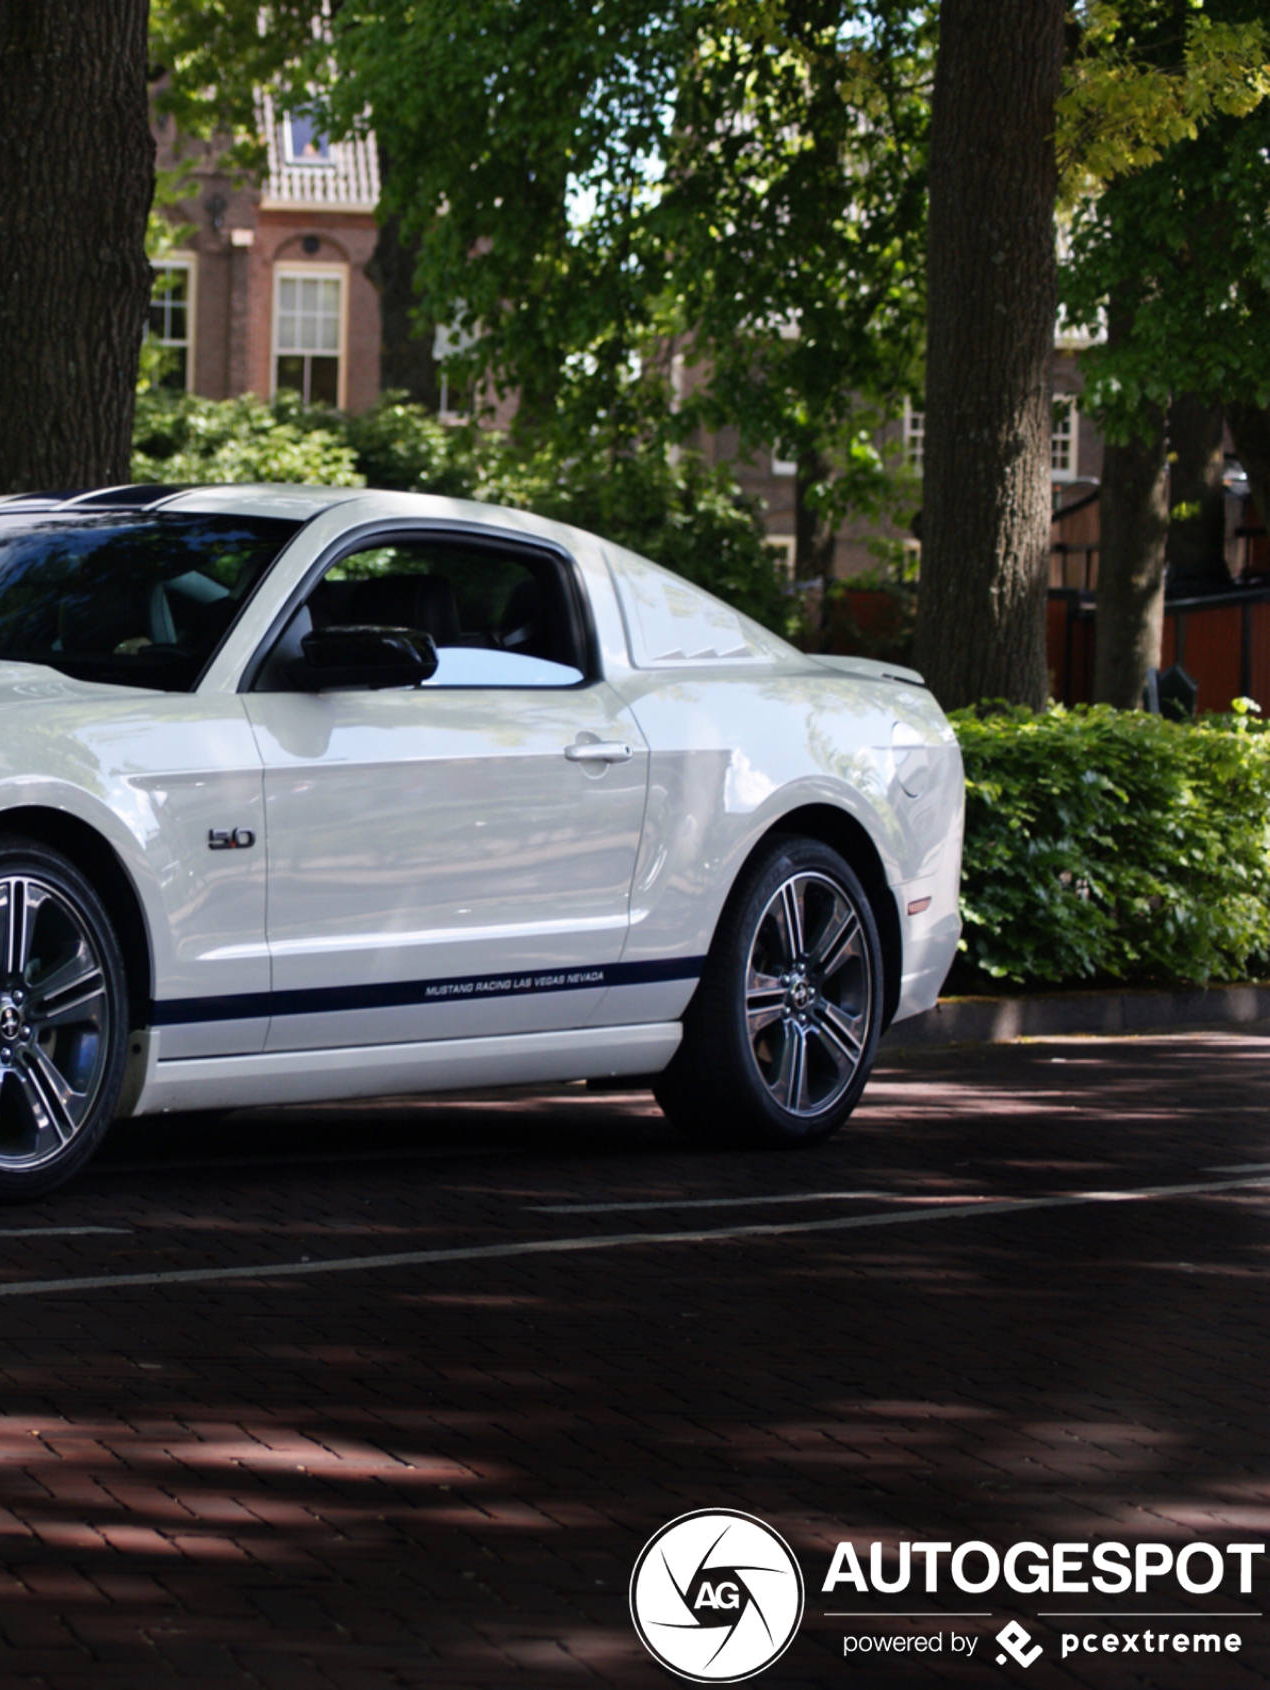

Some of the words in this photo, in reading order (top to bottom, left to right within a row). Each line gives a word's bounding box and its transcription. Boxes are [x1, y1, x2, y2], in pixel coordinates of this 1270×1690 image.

[208, 827, 255, 850] 5.0
[425, 982, 474, 997] MUSTANG
[475, 979, 512, 993] RACING
[513, 977, 532, 989] LAS
[534, 974, 565, 987] VEGAS
[567, 970, 605, 984] NEVADA
